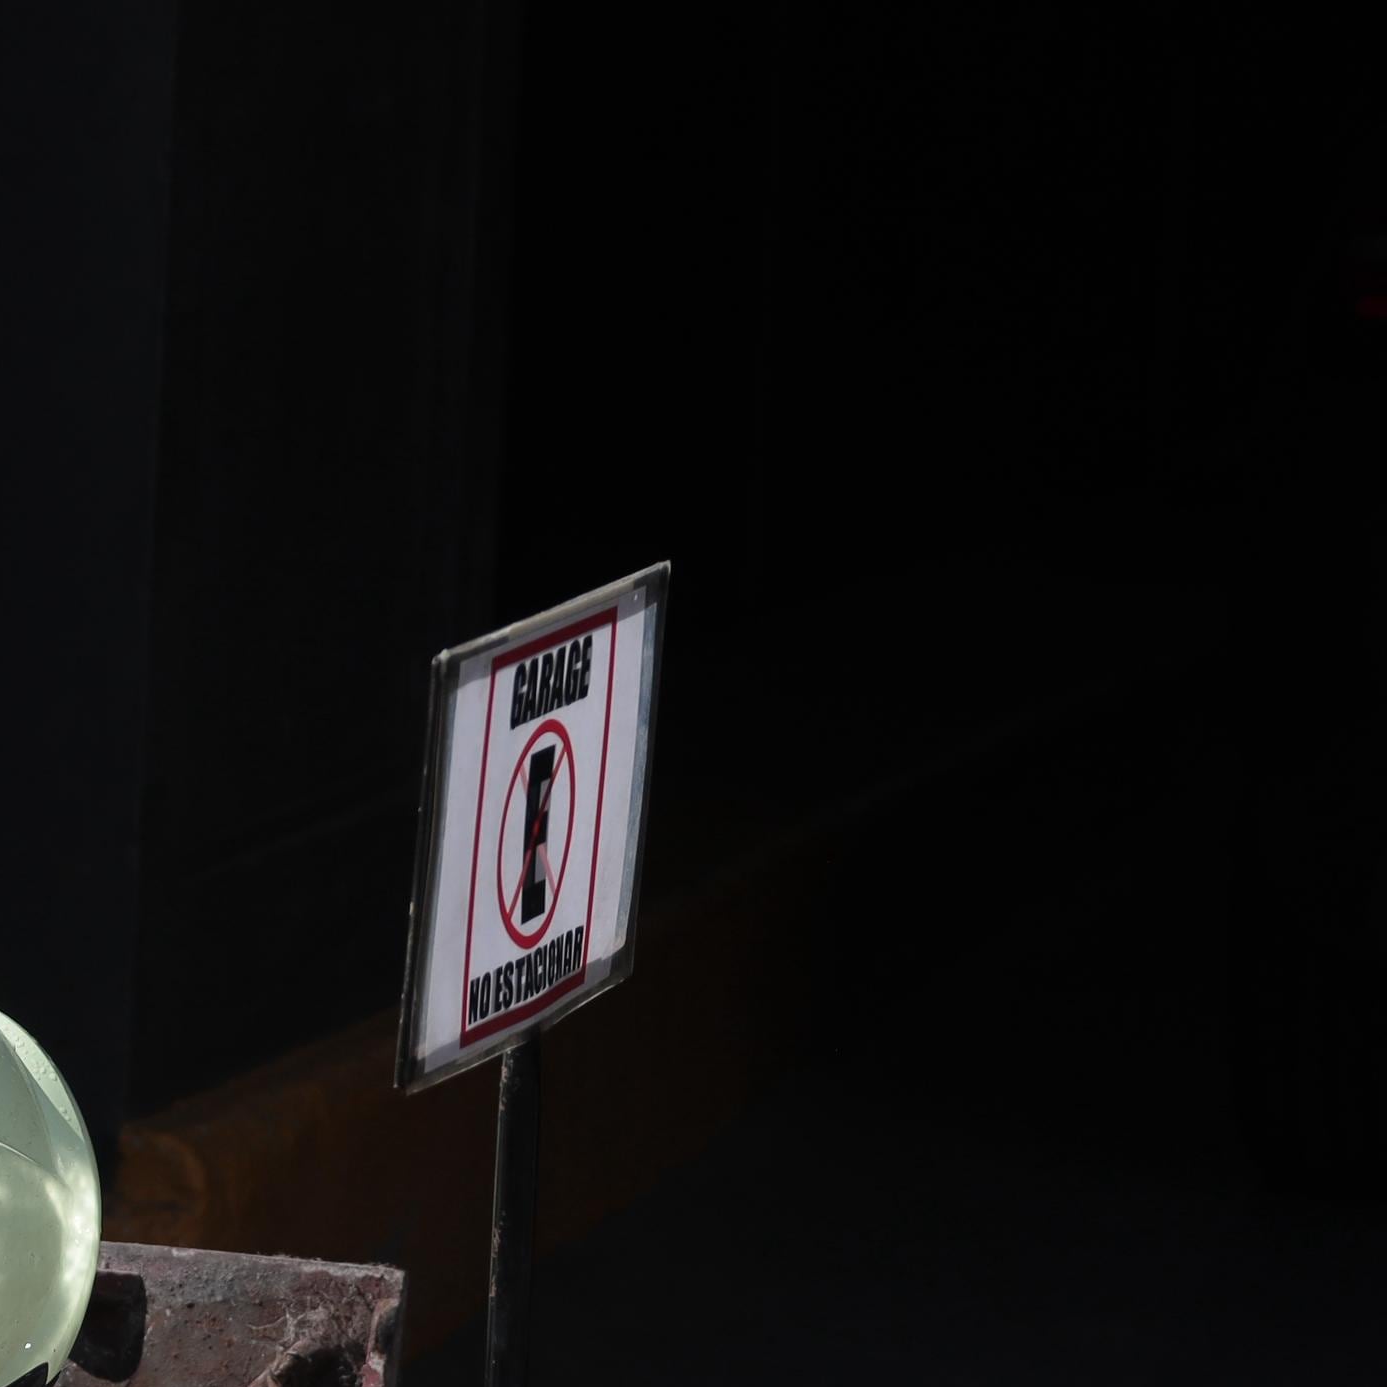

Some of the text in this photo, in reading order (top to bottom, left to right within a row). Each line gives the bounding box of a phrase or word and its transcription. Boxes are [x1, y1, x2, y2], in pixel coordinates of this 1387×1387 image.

[510, 635, 593, 730] GARAGE
[468, 925, 585, 1025] NO ESTACIONAR
